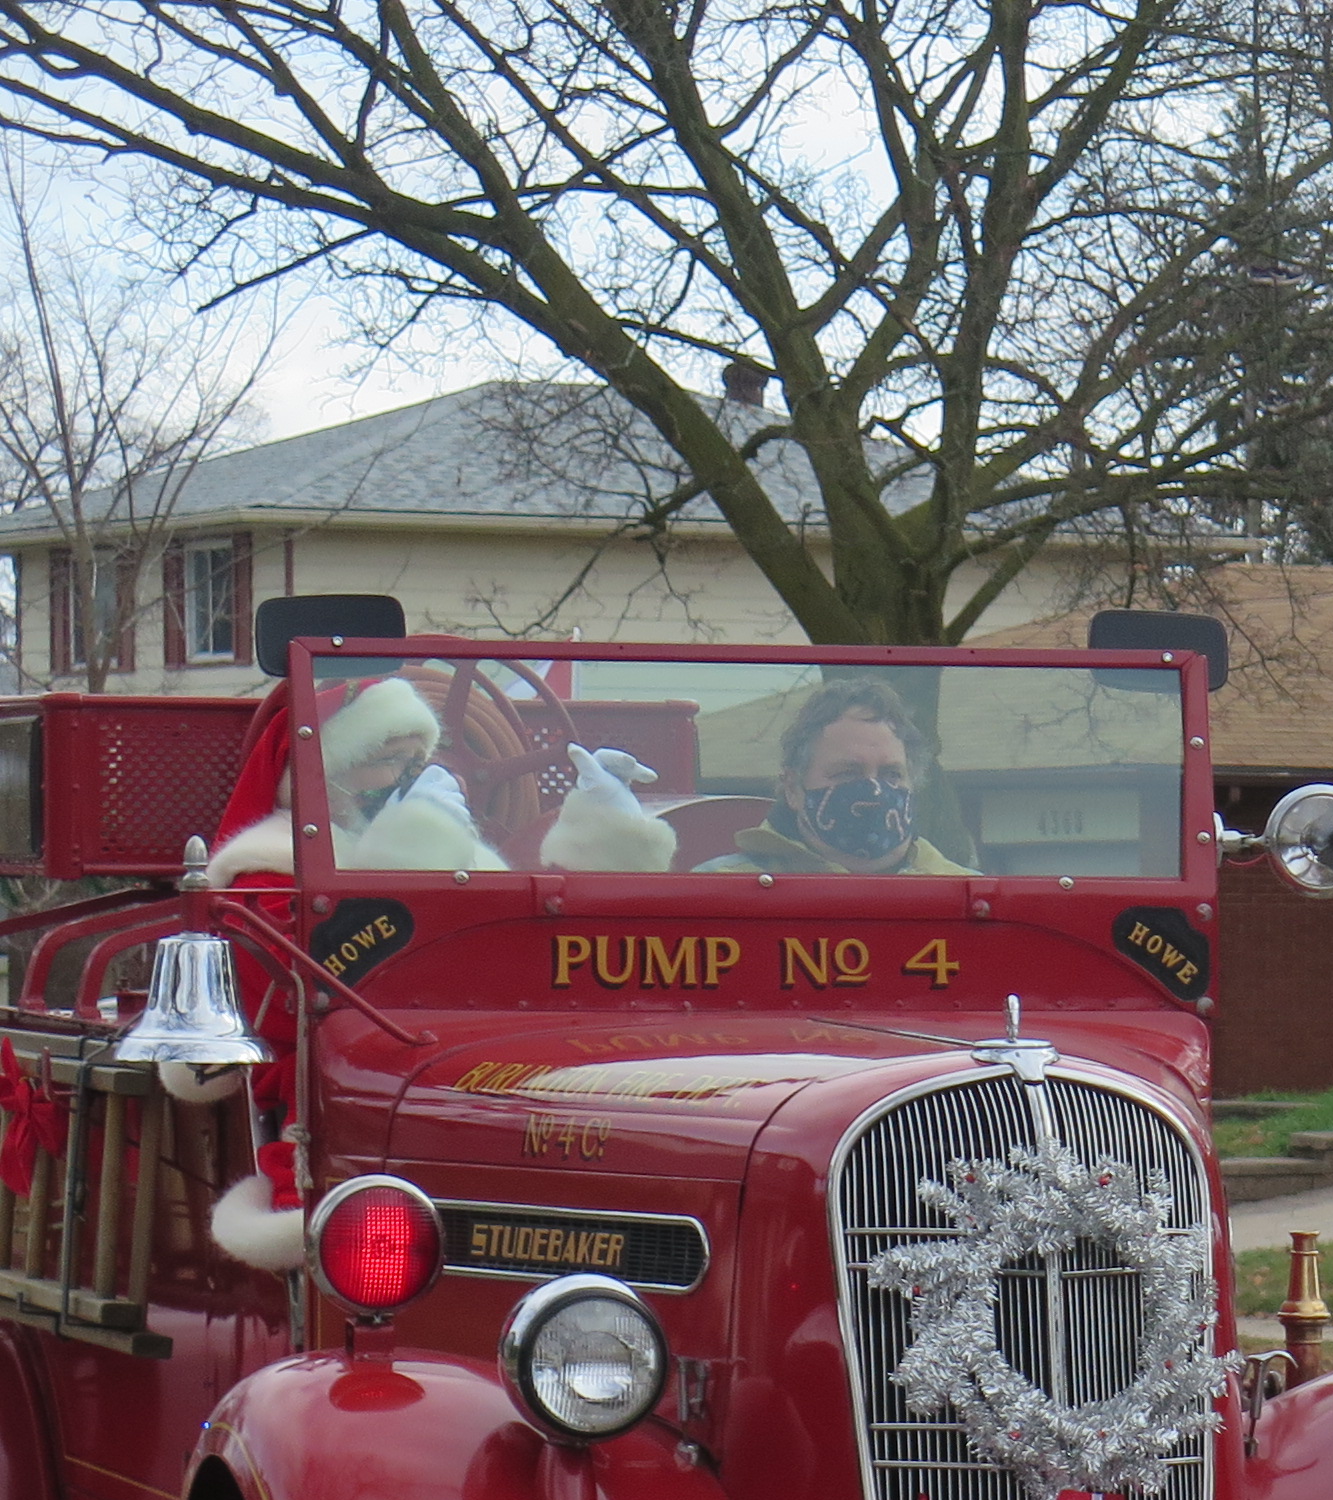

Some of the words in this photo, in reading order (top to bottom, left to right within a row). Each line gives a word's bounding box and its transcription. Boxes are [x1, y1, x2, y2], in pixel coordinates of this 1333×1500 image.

[323, 915, 397, 977] HOWE
[553, 934, 741, 988] PUMP
[903, 938, 961, 988] 4
[1127, 921, 1199, 985] HOWE
[558, 1116, 575, 1155] 4
[470, 1224, 624, 1267] STUDEBAKER
